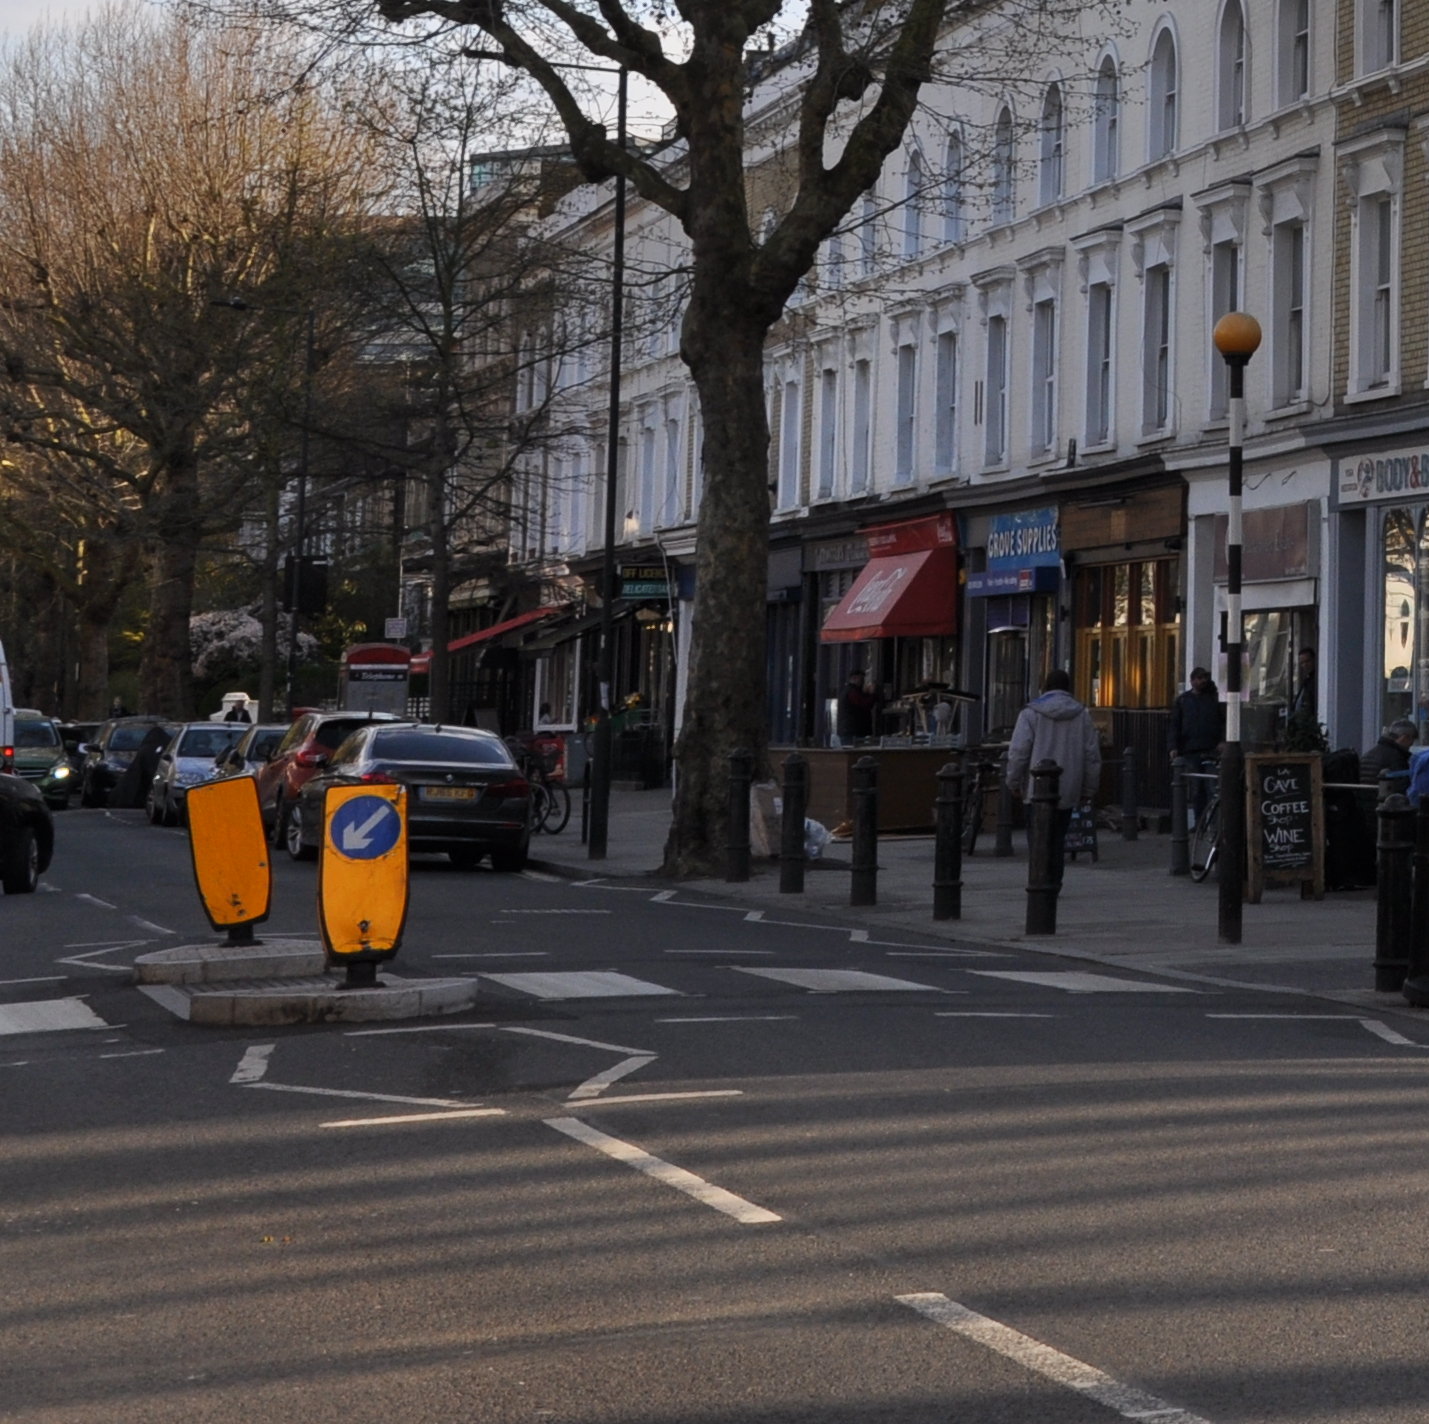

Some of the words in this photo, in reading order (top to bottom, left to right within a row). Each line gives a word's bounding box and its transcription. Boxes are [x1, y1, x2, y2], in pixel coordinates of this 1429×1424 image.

[988, 529, 1015, 559] GROVE
[1016, 522, 1057, 555] SUPPLIES
[1263, 776, 1299, 794] CAVE
[1261, 800, 1310, 816] COFFEE
[1263, 827, 1305, 844] WINE
